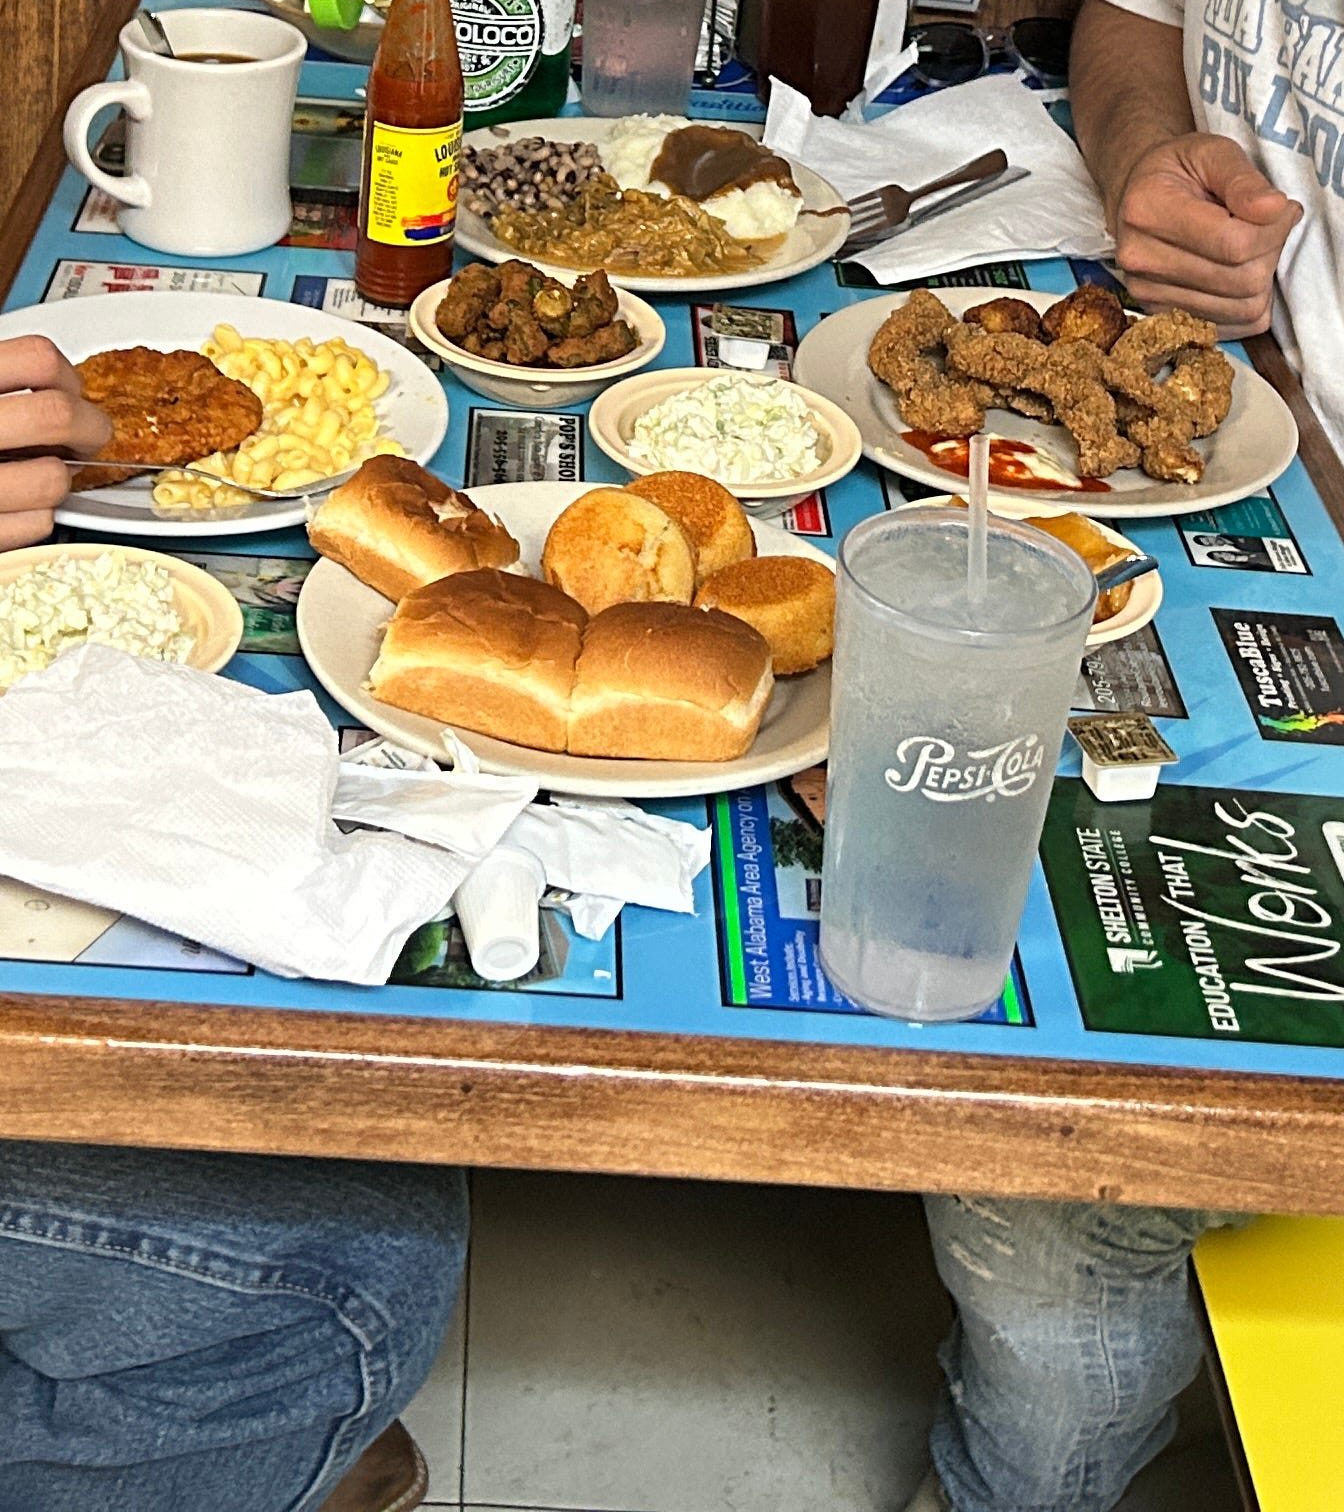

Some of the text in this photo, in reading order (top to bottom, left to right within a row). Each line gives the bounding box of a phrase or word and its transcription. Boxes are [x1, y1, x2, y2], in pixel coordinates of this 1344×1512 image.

[558, 417, 576, 451] POP'S
[1234, 621, 1284, 708] TuscaBlue
[737, 796, 774, 1001] West Alabama Area Agency on
[1077, 826, 1131, 945] SHELTON STATE
[1111, 829, 1154, 945] COMMUNITY COLLEGE
[1167, 852, 1240, 1033] EDUCATION THAT
